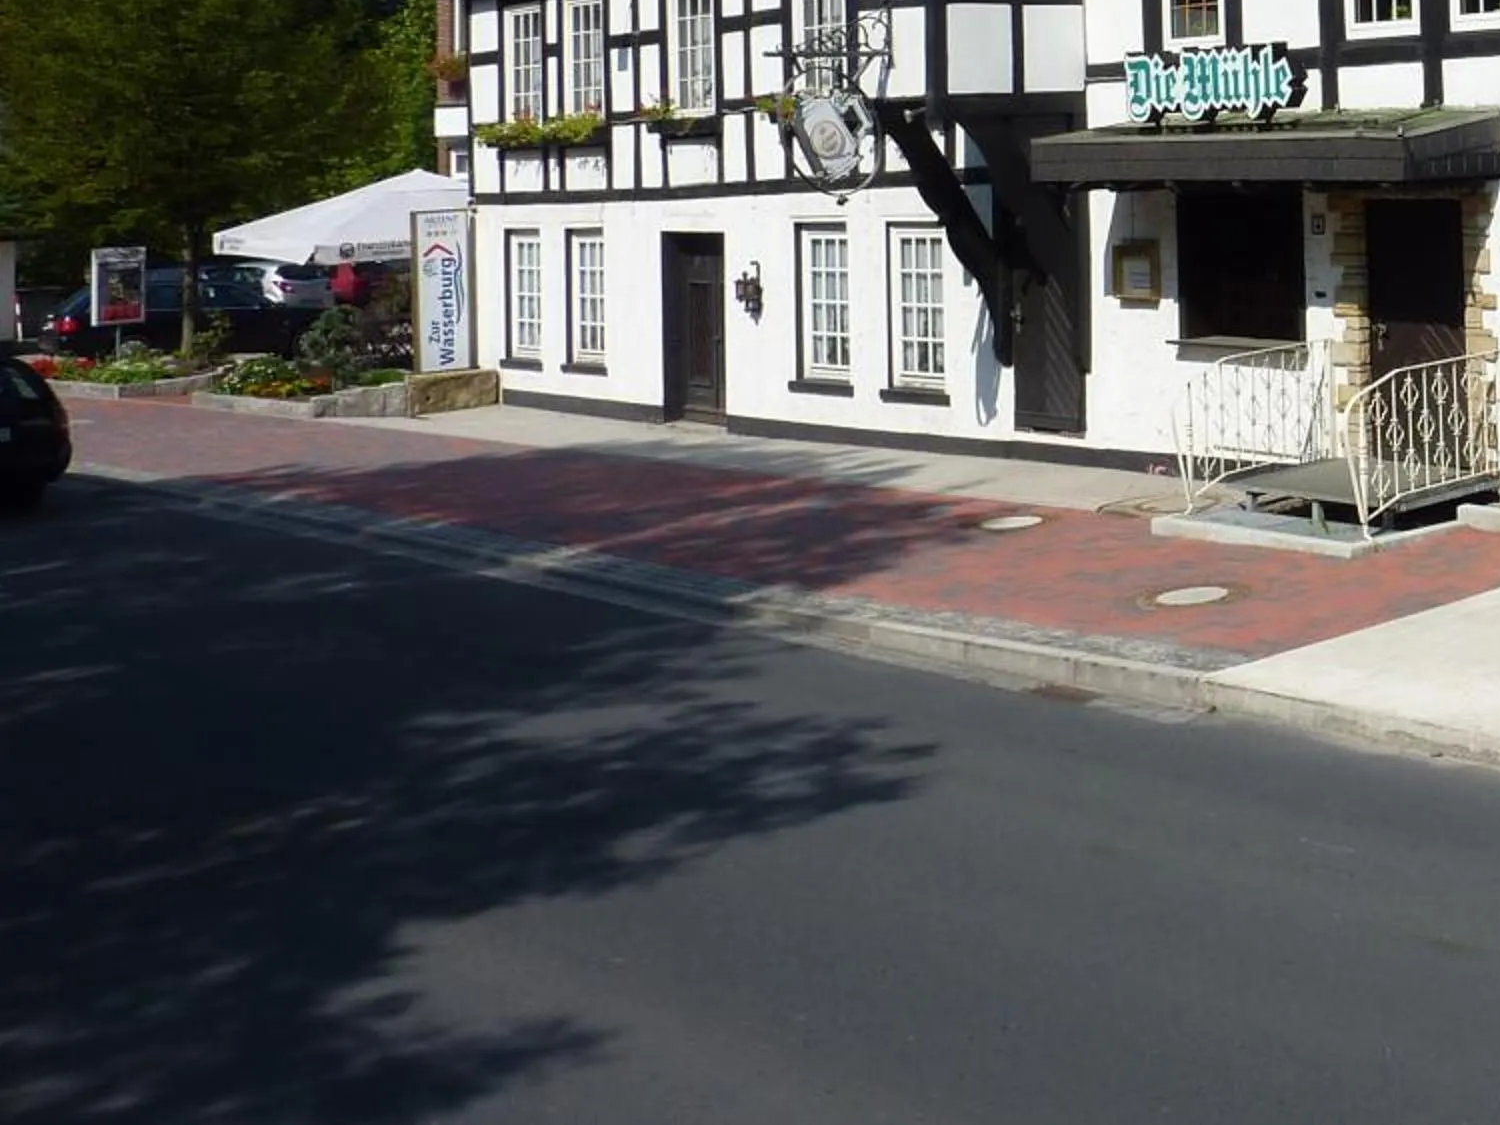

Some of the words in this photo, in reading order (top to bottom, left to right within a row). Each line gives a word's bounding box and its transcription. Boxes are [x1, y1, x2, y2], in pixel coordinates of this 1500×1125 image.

[1125, 54, 1179, 122] Die
[1180, 45, 1292, 120] Mühle
[428, 320, 440, 345] Zur
[438, 257, 457, 366] Wasserburg
